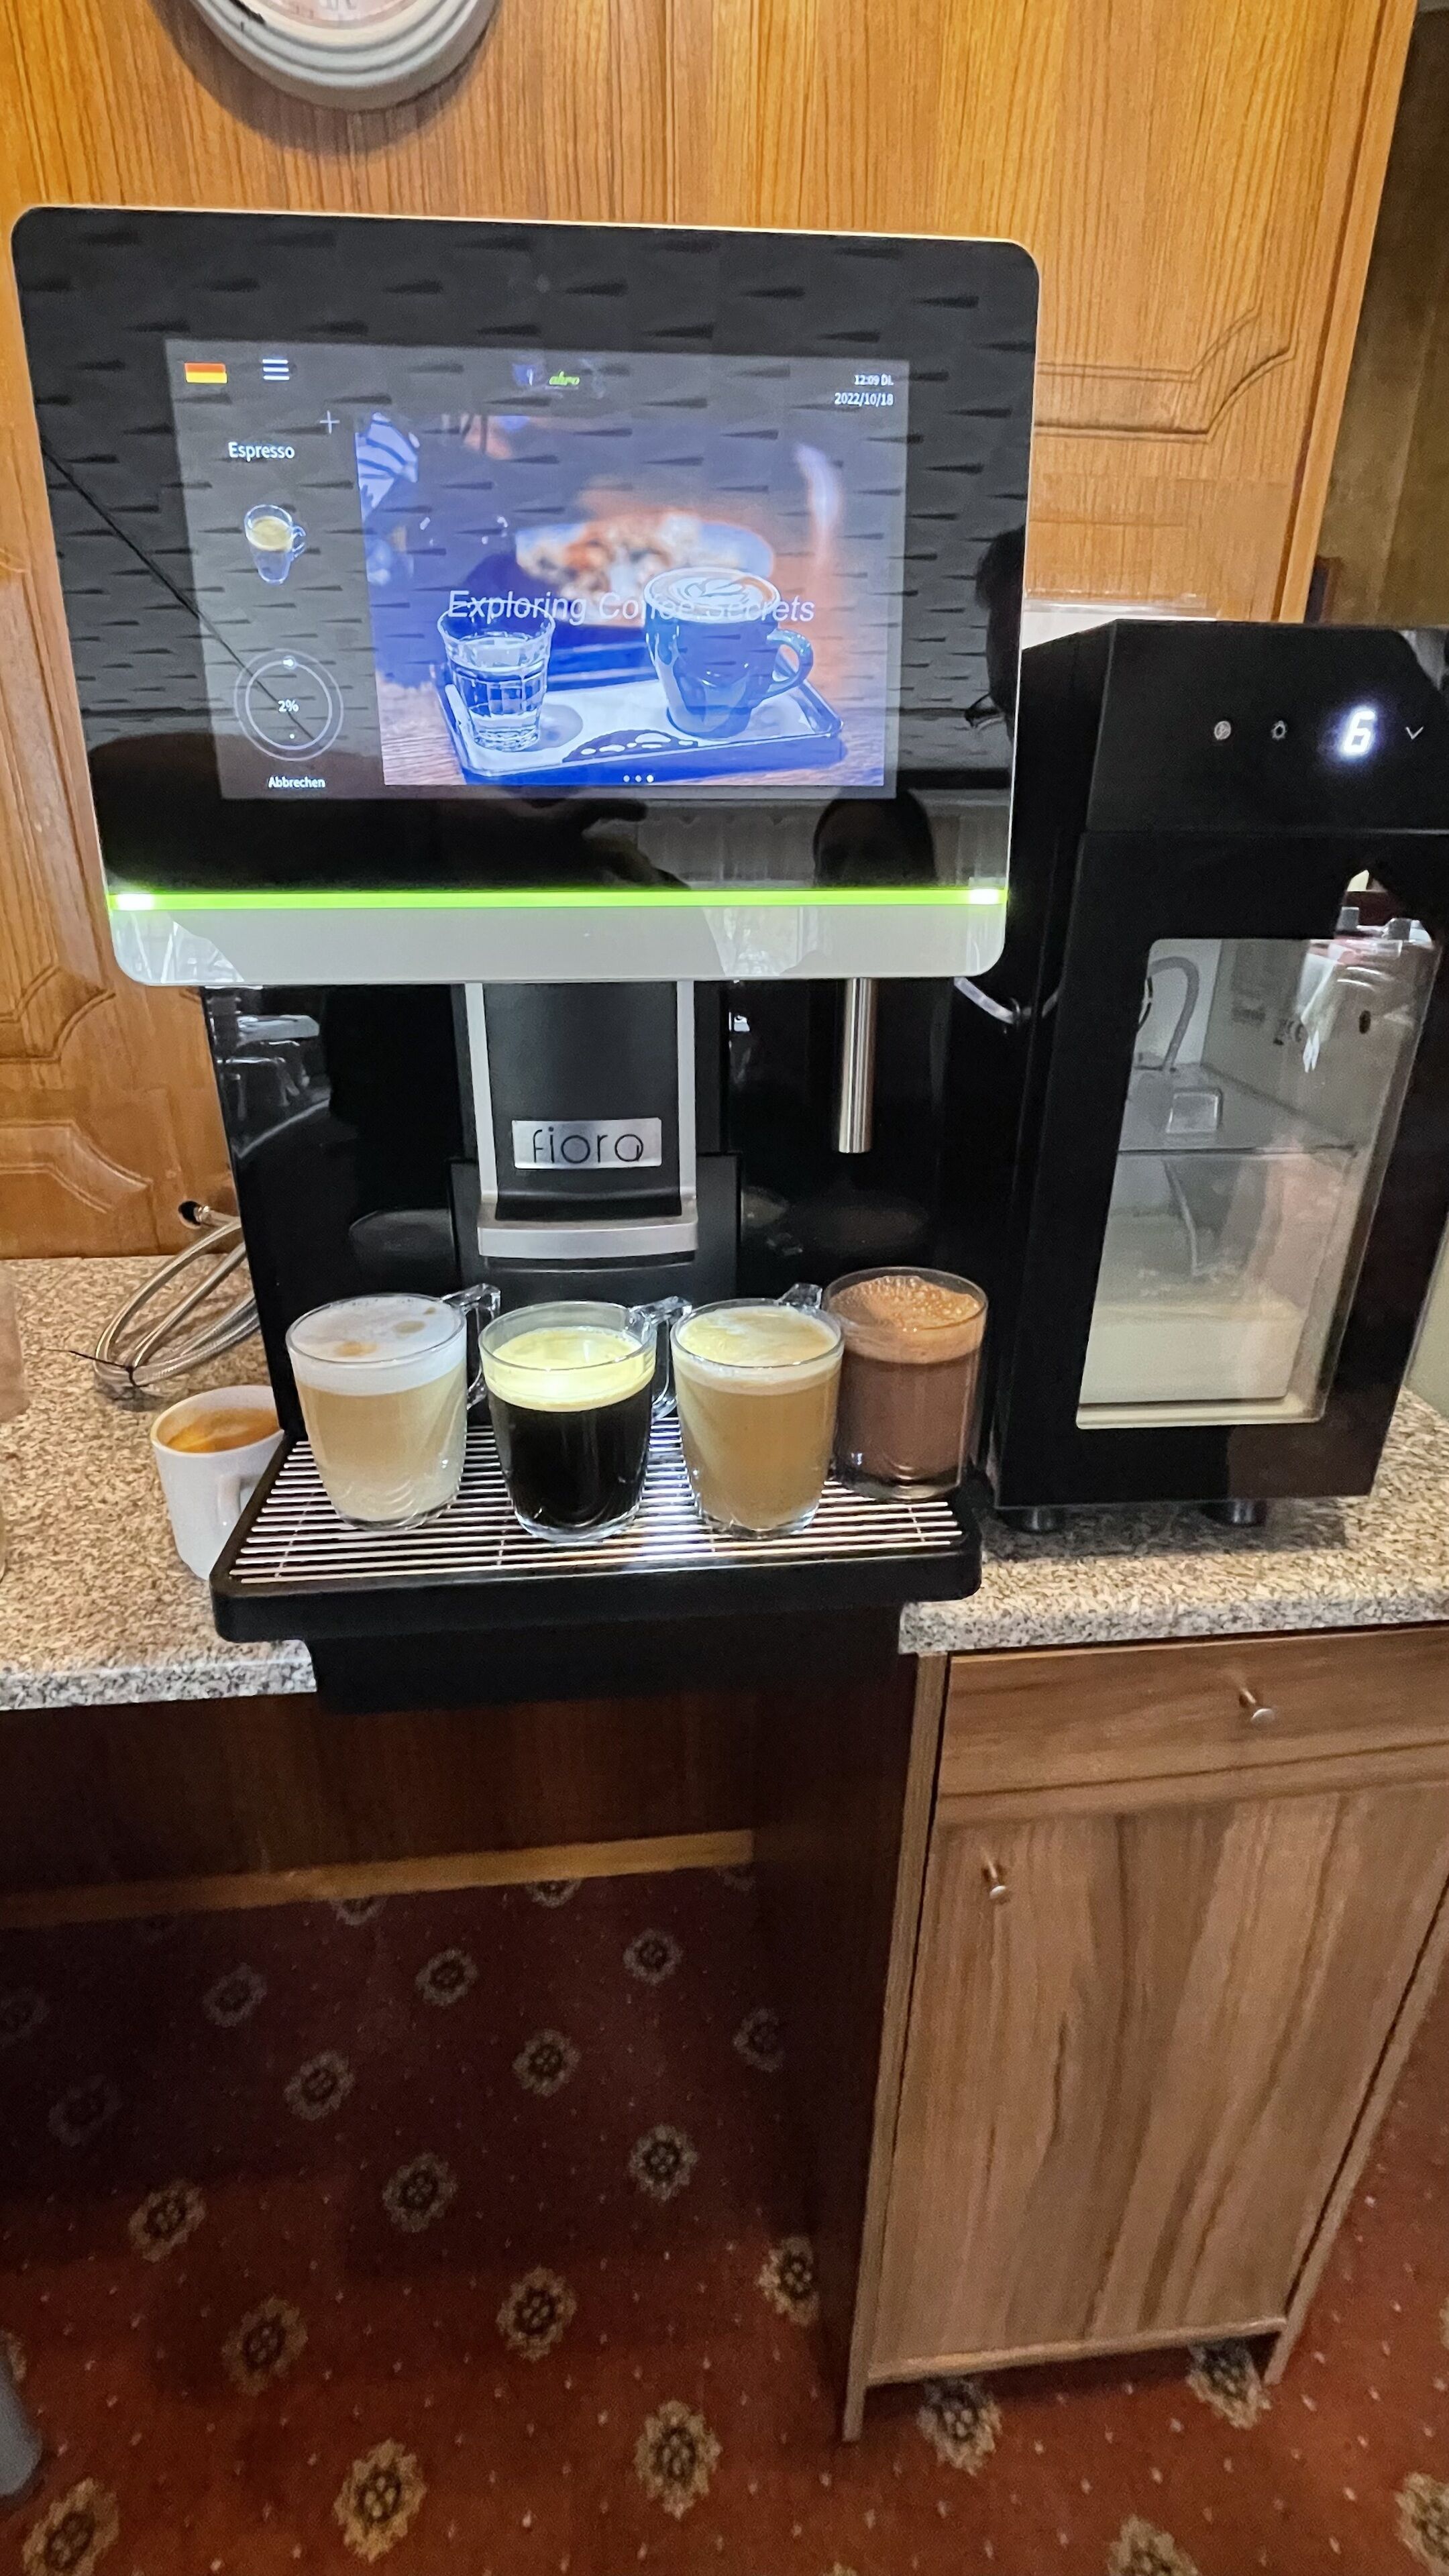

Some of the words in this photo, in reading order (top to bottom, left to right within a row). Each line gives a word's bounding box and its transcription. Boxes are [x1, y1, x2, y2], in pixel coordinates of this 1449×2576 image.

[854, 374, 880, 386] 12:09
[834, 392, 894, 407] 2022/10/18
[228, 441, 295, 462] Espresso
[447, 590, 586, 626] Exploring
[278, 699, 299, 712] 2%
[1342, 709, 1377, 754] 6
[268, 776, 326, 788] Abbrechen
[532, 1126, 644, 1164] fiora
